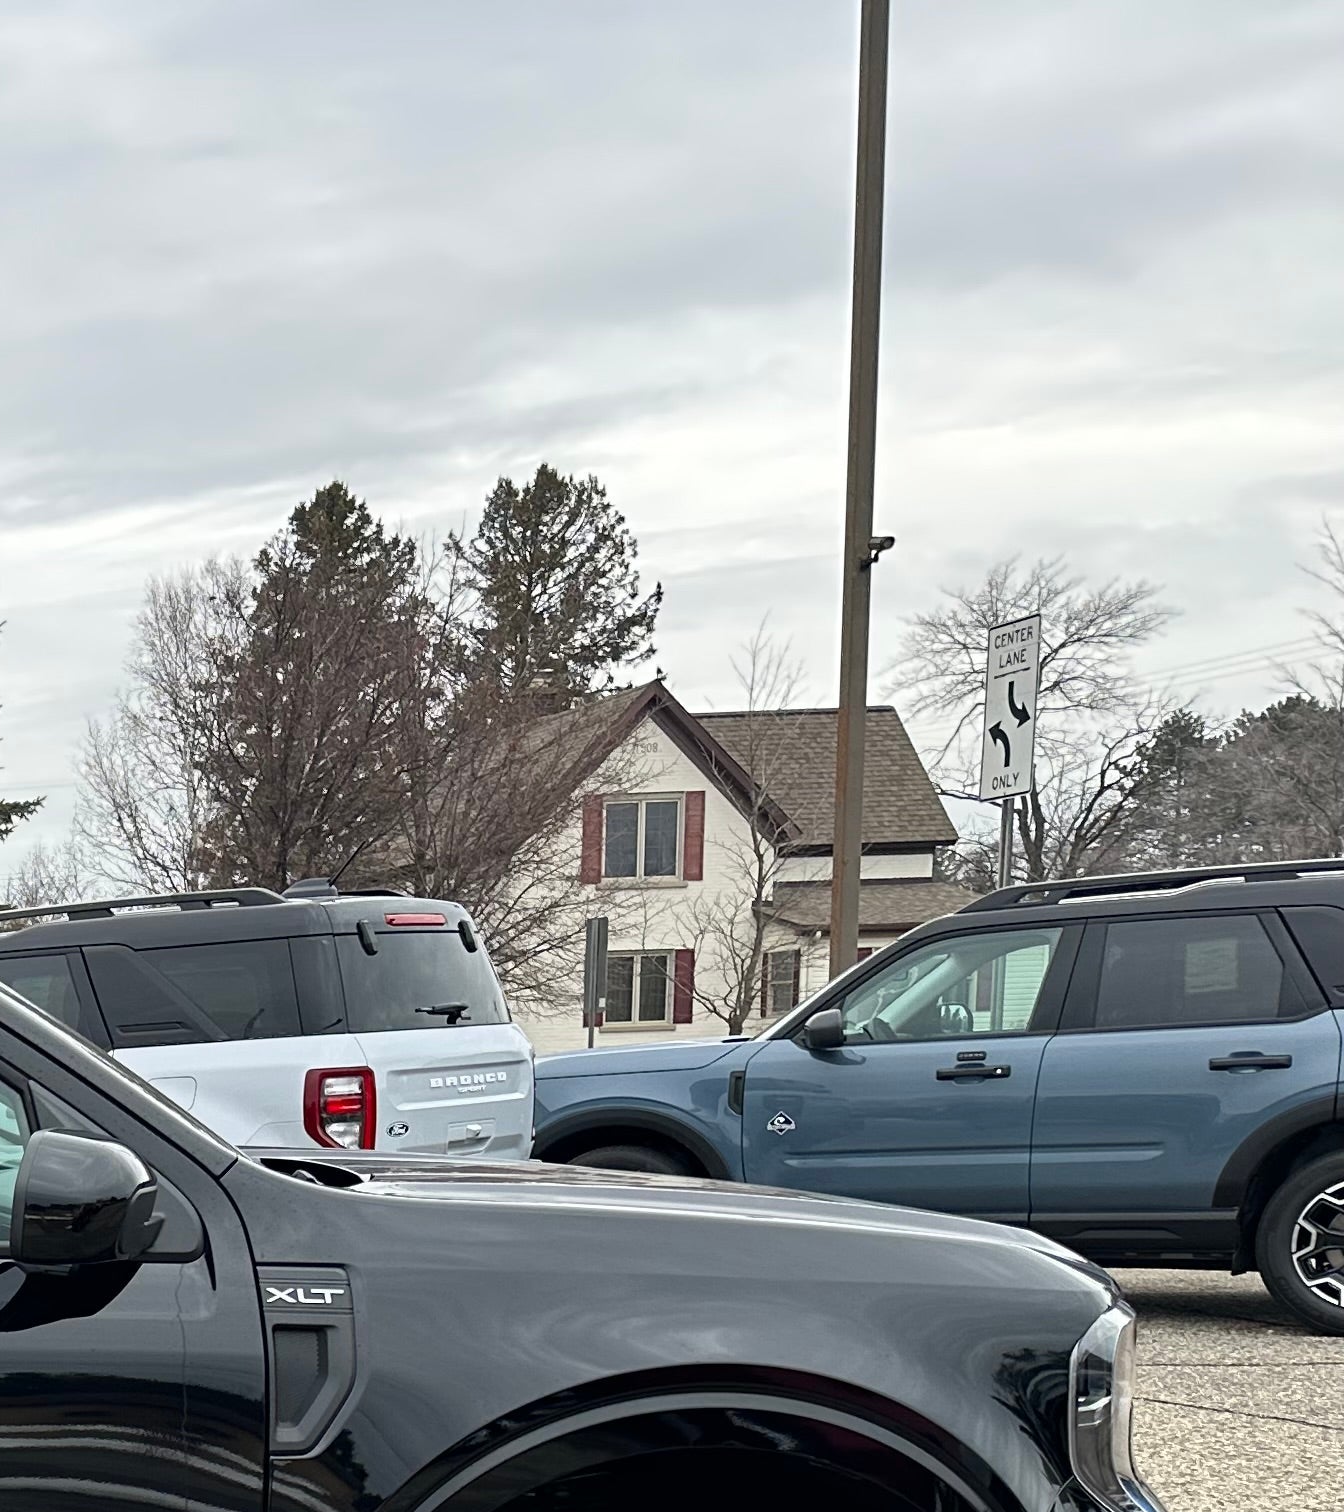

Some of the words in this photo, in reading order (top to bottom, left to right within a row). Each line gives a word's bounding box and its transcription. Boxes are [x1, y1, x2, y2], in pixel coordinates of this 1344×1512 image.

[994, 626, 1034, 649] CENTER
[999, 650, 1027, 669] LANE
[991, 772, 1020, 791] ONLY
[430, 1071, 507, 1088] BRONCO
[265, 1287, 345, 1304] XLT
